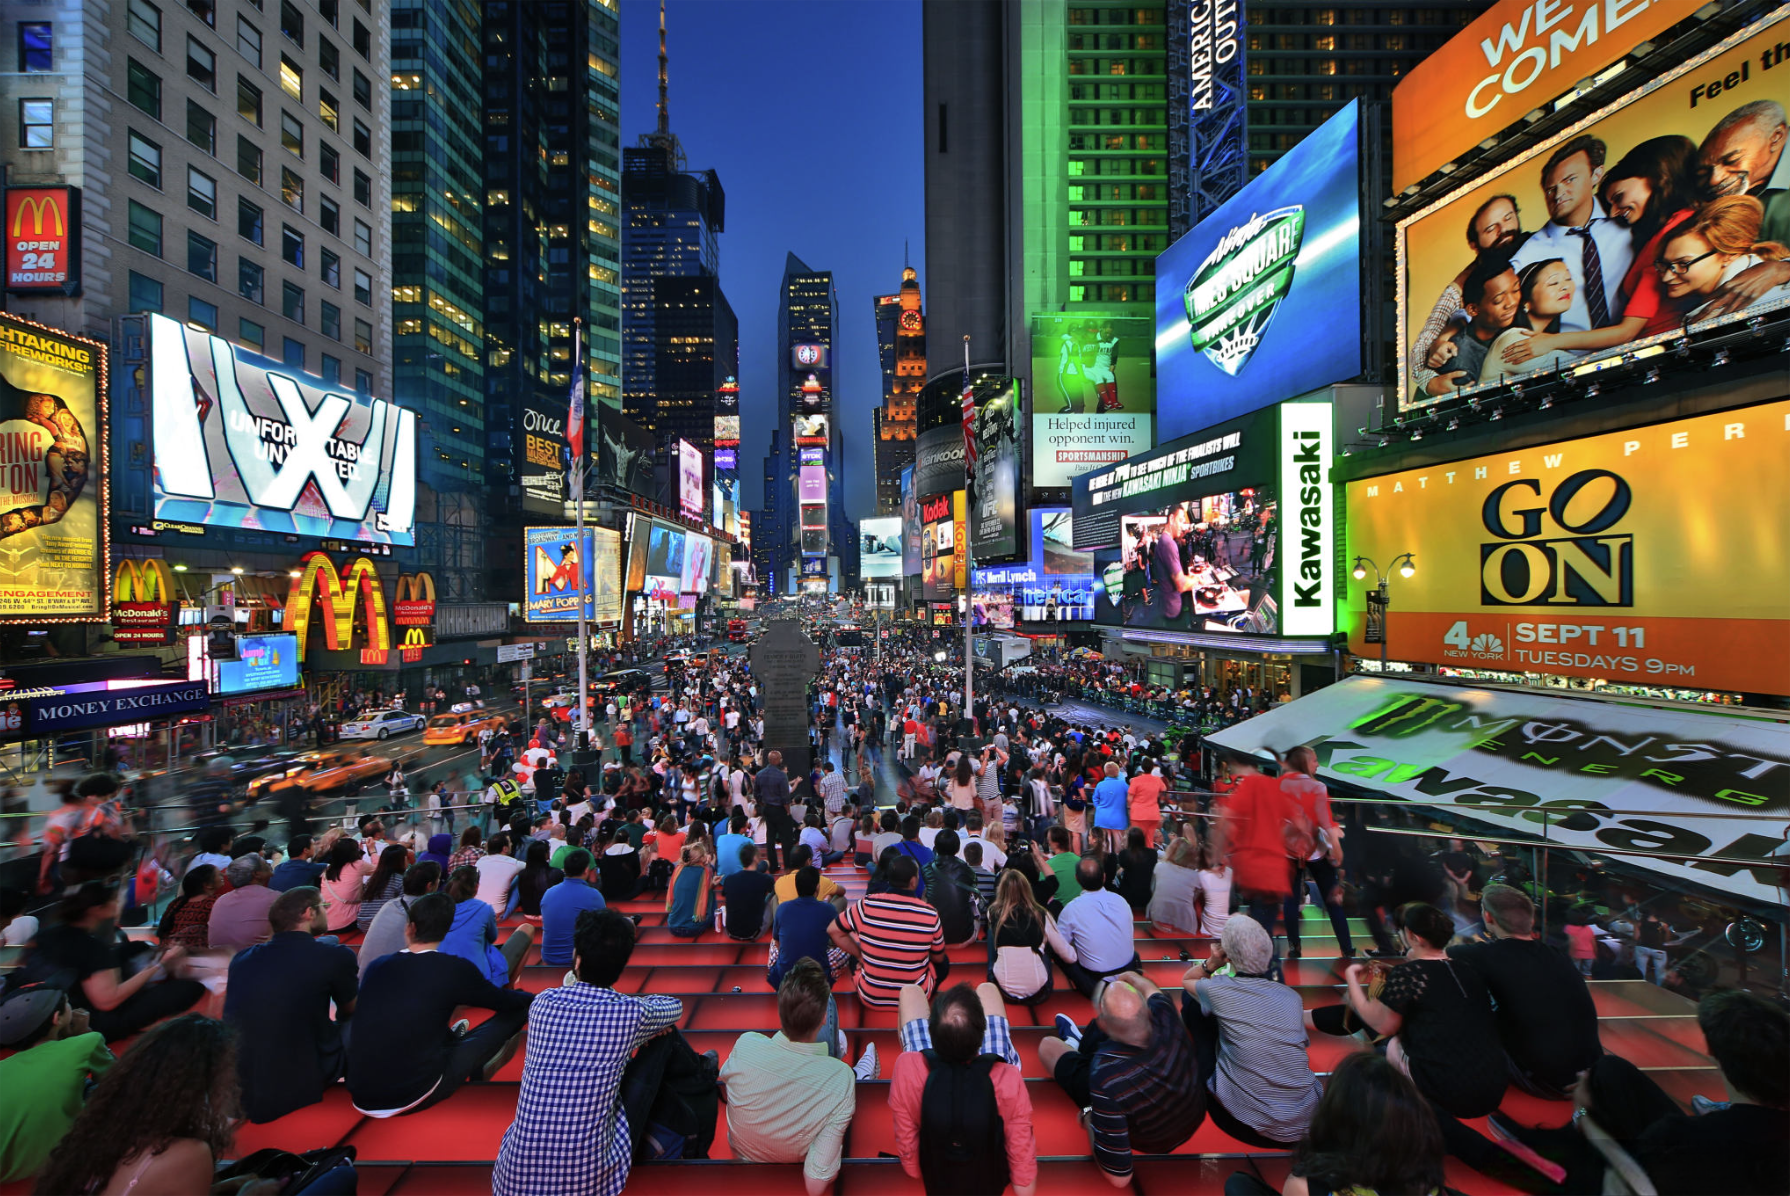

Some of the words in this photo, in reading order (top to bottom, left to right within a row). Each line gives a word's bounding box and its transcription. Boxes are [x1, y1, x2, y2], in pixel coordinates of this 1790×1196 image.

[1690, 60, 1749, 109] Feel
[16, 240, 60, 253] OPEN
[21, 253, 56, 271] 24
[11, 271, 66, 284] HOURS
[1048, 417, 1091, 433] Helped
[1094, 417, 1136, 432] injured
[526, 434, 561, 457] BEST
[1048, 434, 1108, 447] opponent
[1109, 431, 1135, 444] win.
[1058, 451, 1126, 462] SPORTSMANSHIP
[10, 463, 38, 495] ON
[1122, 470, 1163, 498] KAWASAKI
[1190, 455, 1235, 480] SPORTBIKES
[1367, 453, 1564, 497] MATTHEW
[12, 493, 39, 505] MUSICAL
[923, 495, 950, 524] Kodak
[982, 500, 998, 518] UFC
[1481, 468, 1633, 540] GO
[1293, 430, 1322, 608] Kawasaki
[986, 570, 1006, 584] Merrill
[1007, 568, 1037, 584] Lynch
[1481, 537, 1633, 605] ON
[113, 609, 169, 618] McDonald's
[529, 599, 554, 611] MARY
[1444, 620, 1472, 651] 4
[1515, 622, 1605, 646] SEPT
[1612, 626, 1645, 649] 11
[1443, 649, 1469, 659] NEW
[1471, 650, 1505, 662] YORK
[1514, 648, 1639, 673] TUESDAYS
[1645, 657, 1696, 677] 9PM
[37, 699, 112, 722] MONEY
[115, 688, 205, 711] EXCHANGE
